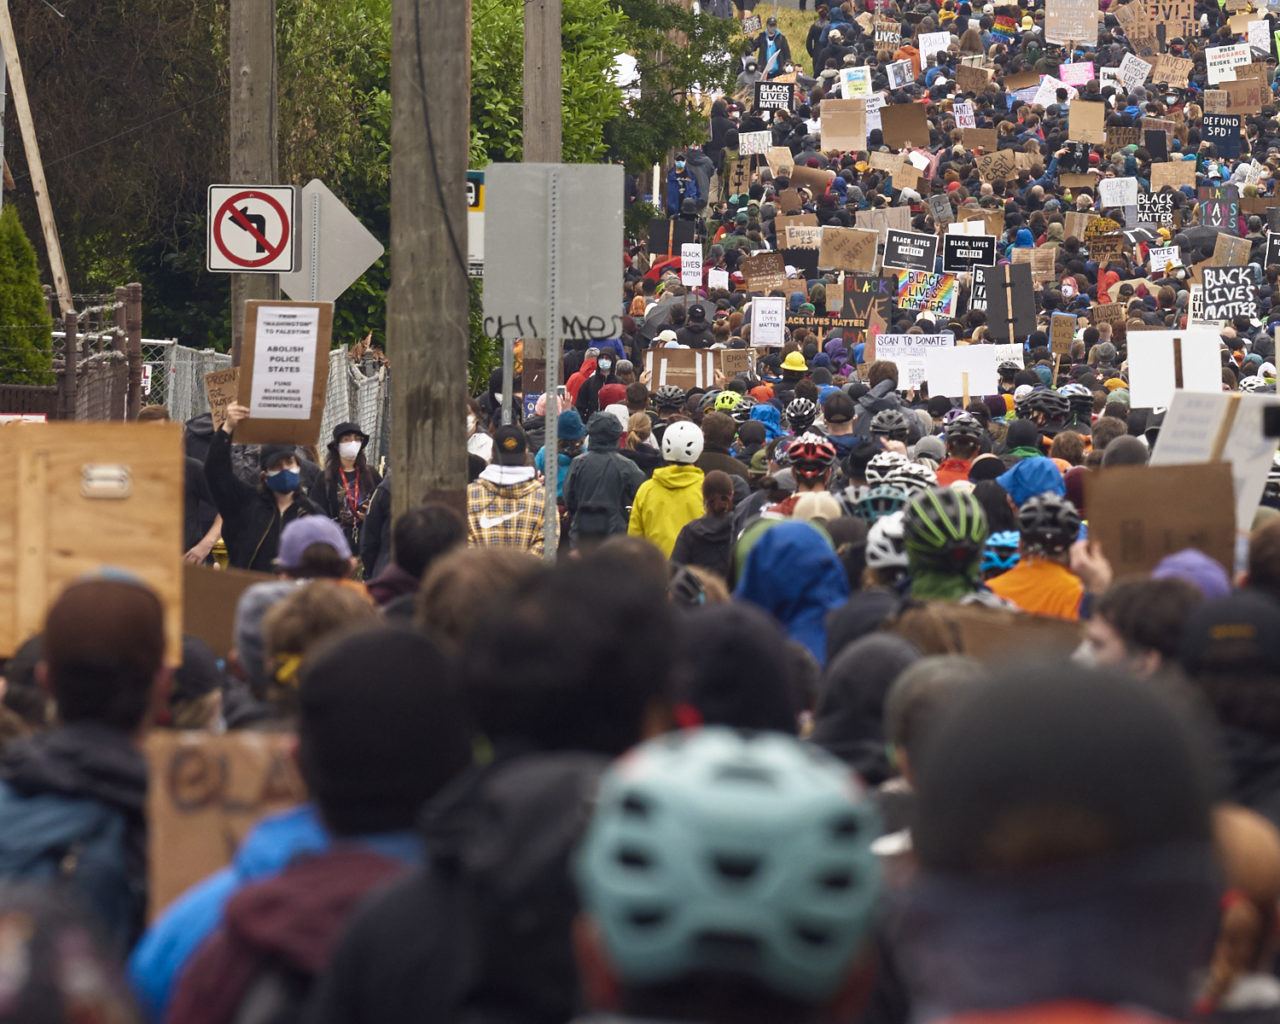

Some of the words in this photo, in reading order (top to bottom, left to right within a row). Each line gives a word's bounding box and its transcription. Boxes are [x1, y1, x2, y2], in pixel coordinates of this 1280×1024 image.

[875, 32, 901, 42] LIVES
[1211, 50, 1246, 60] IGNORANCE
[760, 92, 789, 101] LIVES
[759, 101, 789, 109] MATTER
[1203, 117, 1239, 127] DEFUND
[1207, 127, 1232, 137] SPD!
[1137, 193, 1174, 204] BLACK
[1200, 187, 1233, 201] BLACK
[1137, 204, 1172, 214] LIVES
[1200, 202, 1237, 217] TRANS
[1137, 213, 1174, 223] MATTER
[892, 236, 911, 245] BLACK
[914, 239, 931, 247] LIVES
[682, 250, 700, 258] BLACK
[900, 247, 923, 255] MATTER
[1151, 247, 1176, 256] VOTE!
[682, 261, 700, 269] LIVES
[908, 271, 943, 288] BLACK
[1204, 267, 1252, 288] BLACK
[845, 279, 888, 294] BLACK
[908, 287, 938, 299] LIVES
[1206, 286, 1256, 304] LIVES
[901, 297, 944, 313] MATTER
[1204, 302, 1258, 320] MATTER
[806, 317, 830, 325] LIVES
[832, 318, 865, 327] MATTER
[877, 335, 899, 346] SCAN
[903, 336, 912, 346] TO
[916, 336, 947, 346] DONATE
